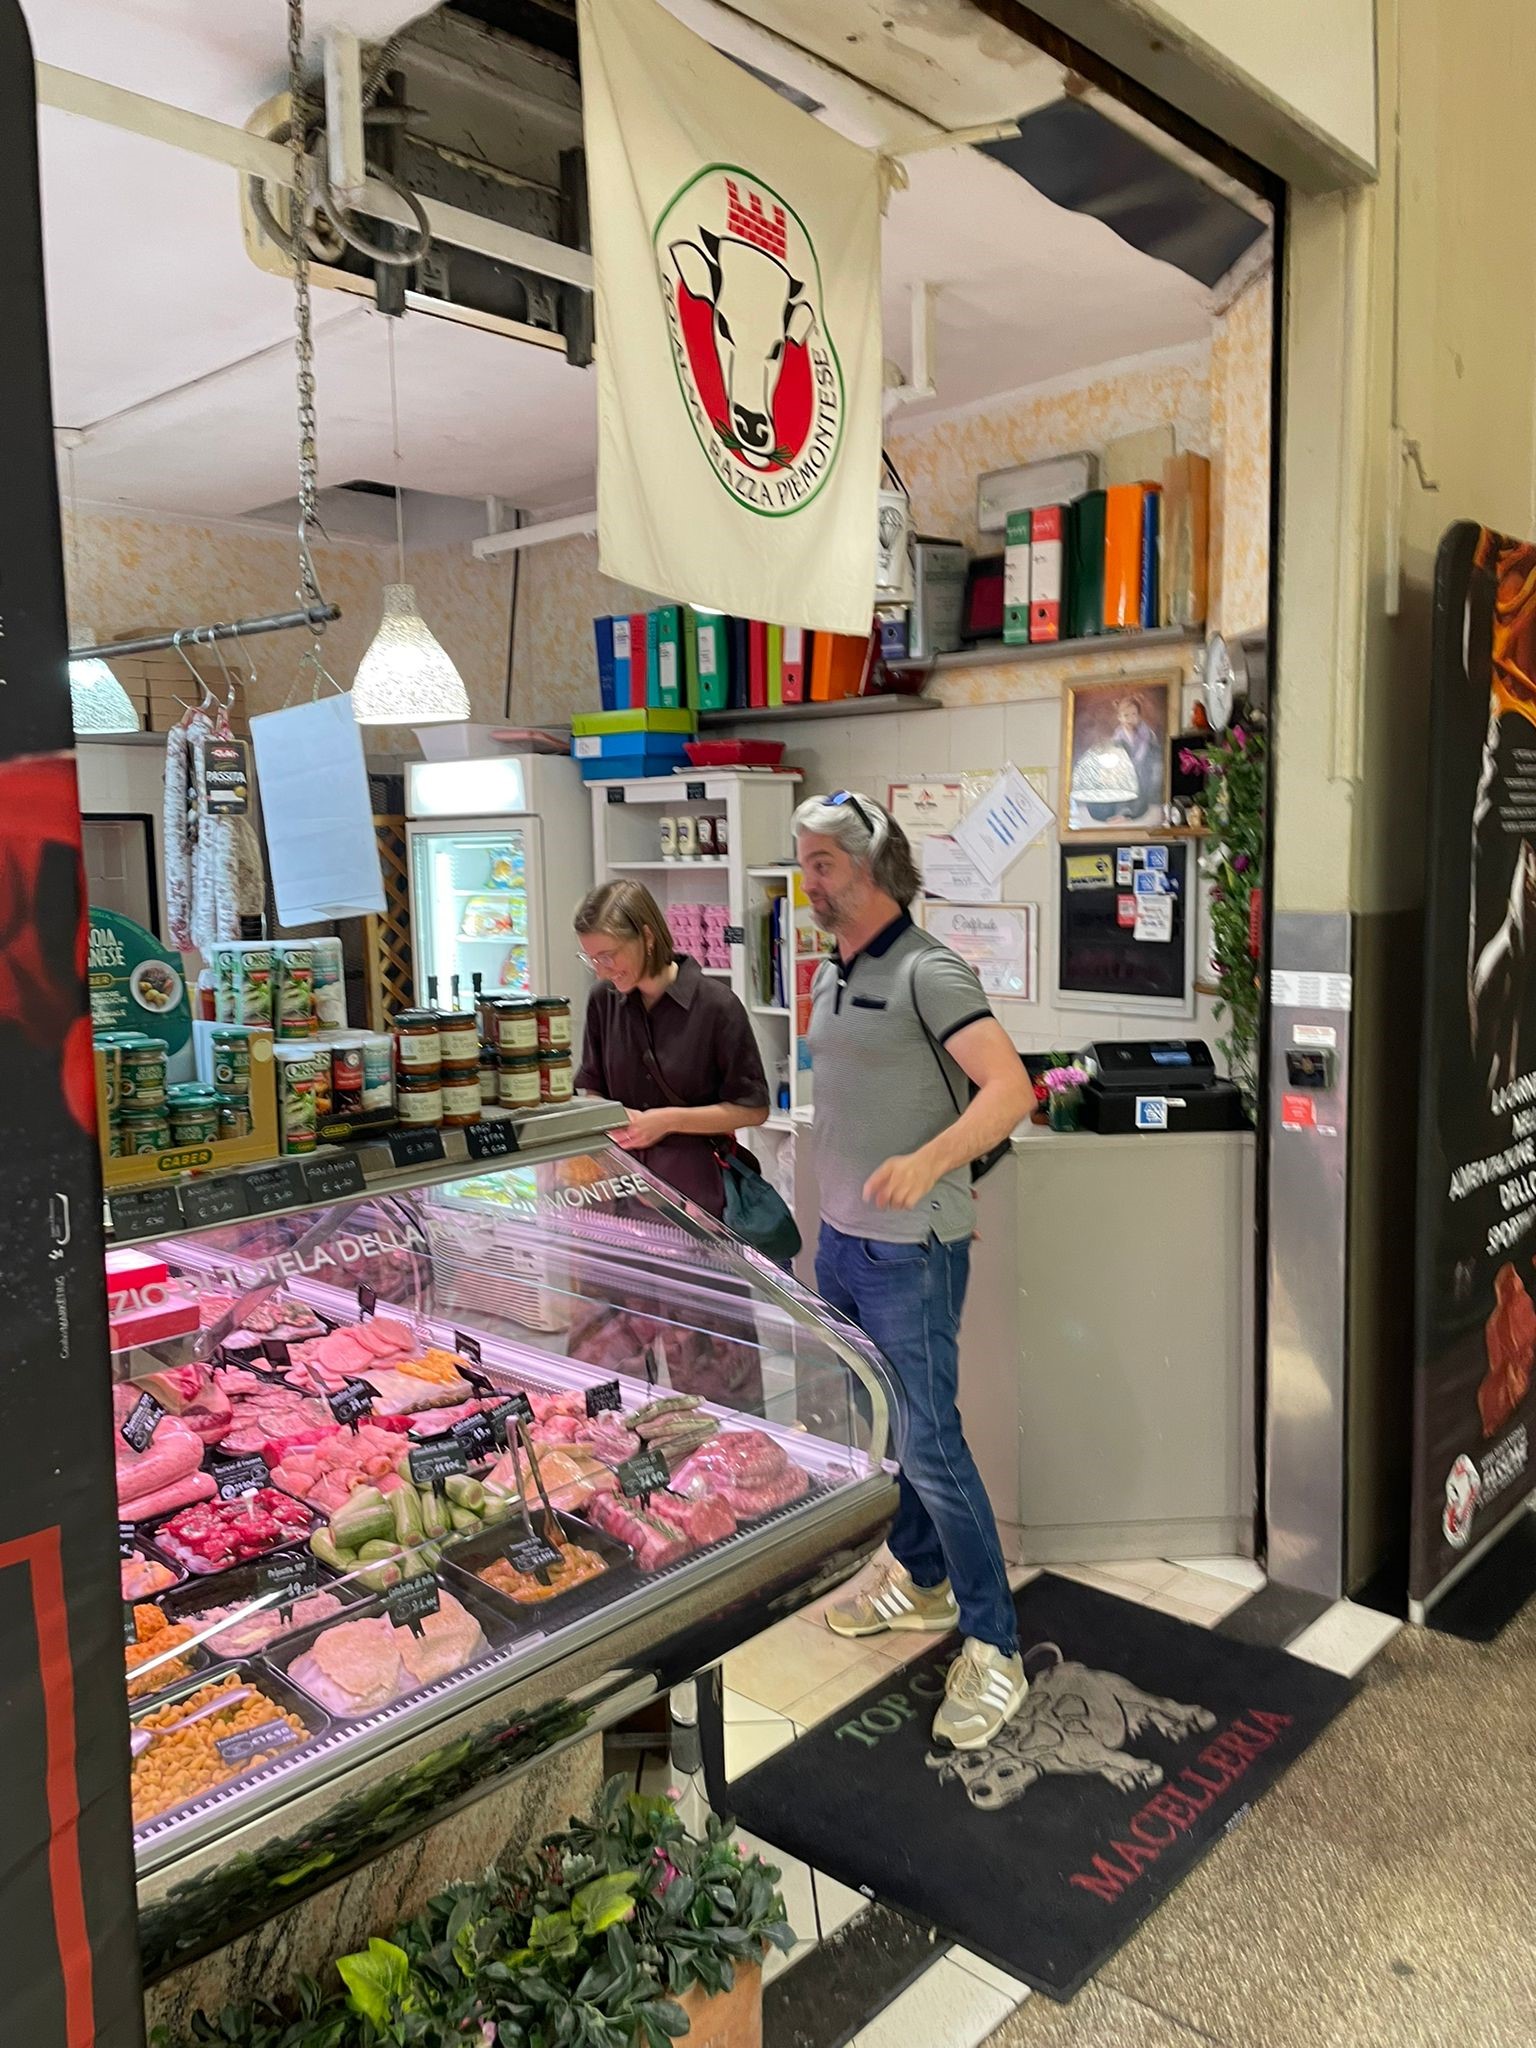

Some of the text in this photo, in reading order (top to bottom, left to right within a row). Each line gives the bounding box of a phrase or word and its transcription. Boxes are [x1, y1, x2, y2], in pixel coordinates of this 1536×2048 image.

[776, 347, 837, 505] PIEMONTESE
[161, 1151, 211, 1170] CABER
[215, 1245, 336, 1289] TUTELA
[336, 1224, 428, 1262] DELLA
[834, 1693, 919, 1749] TOP
[1070, 1707, 1294, 1904] MACELLERIA
